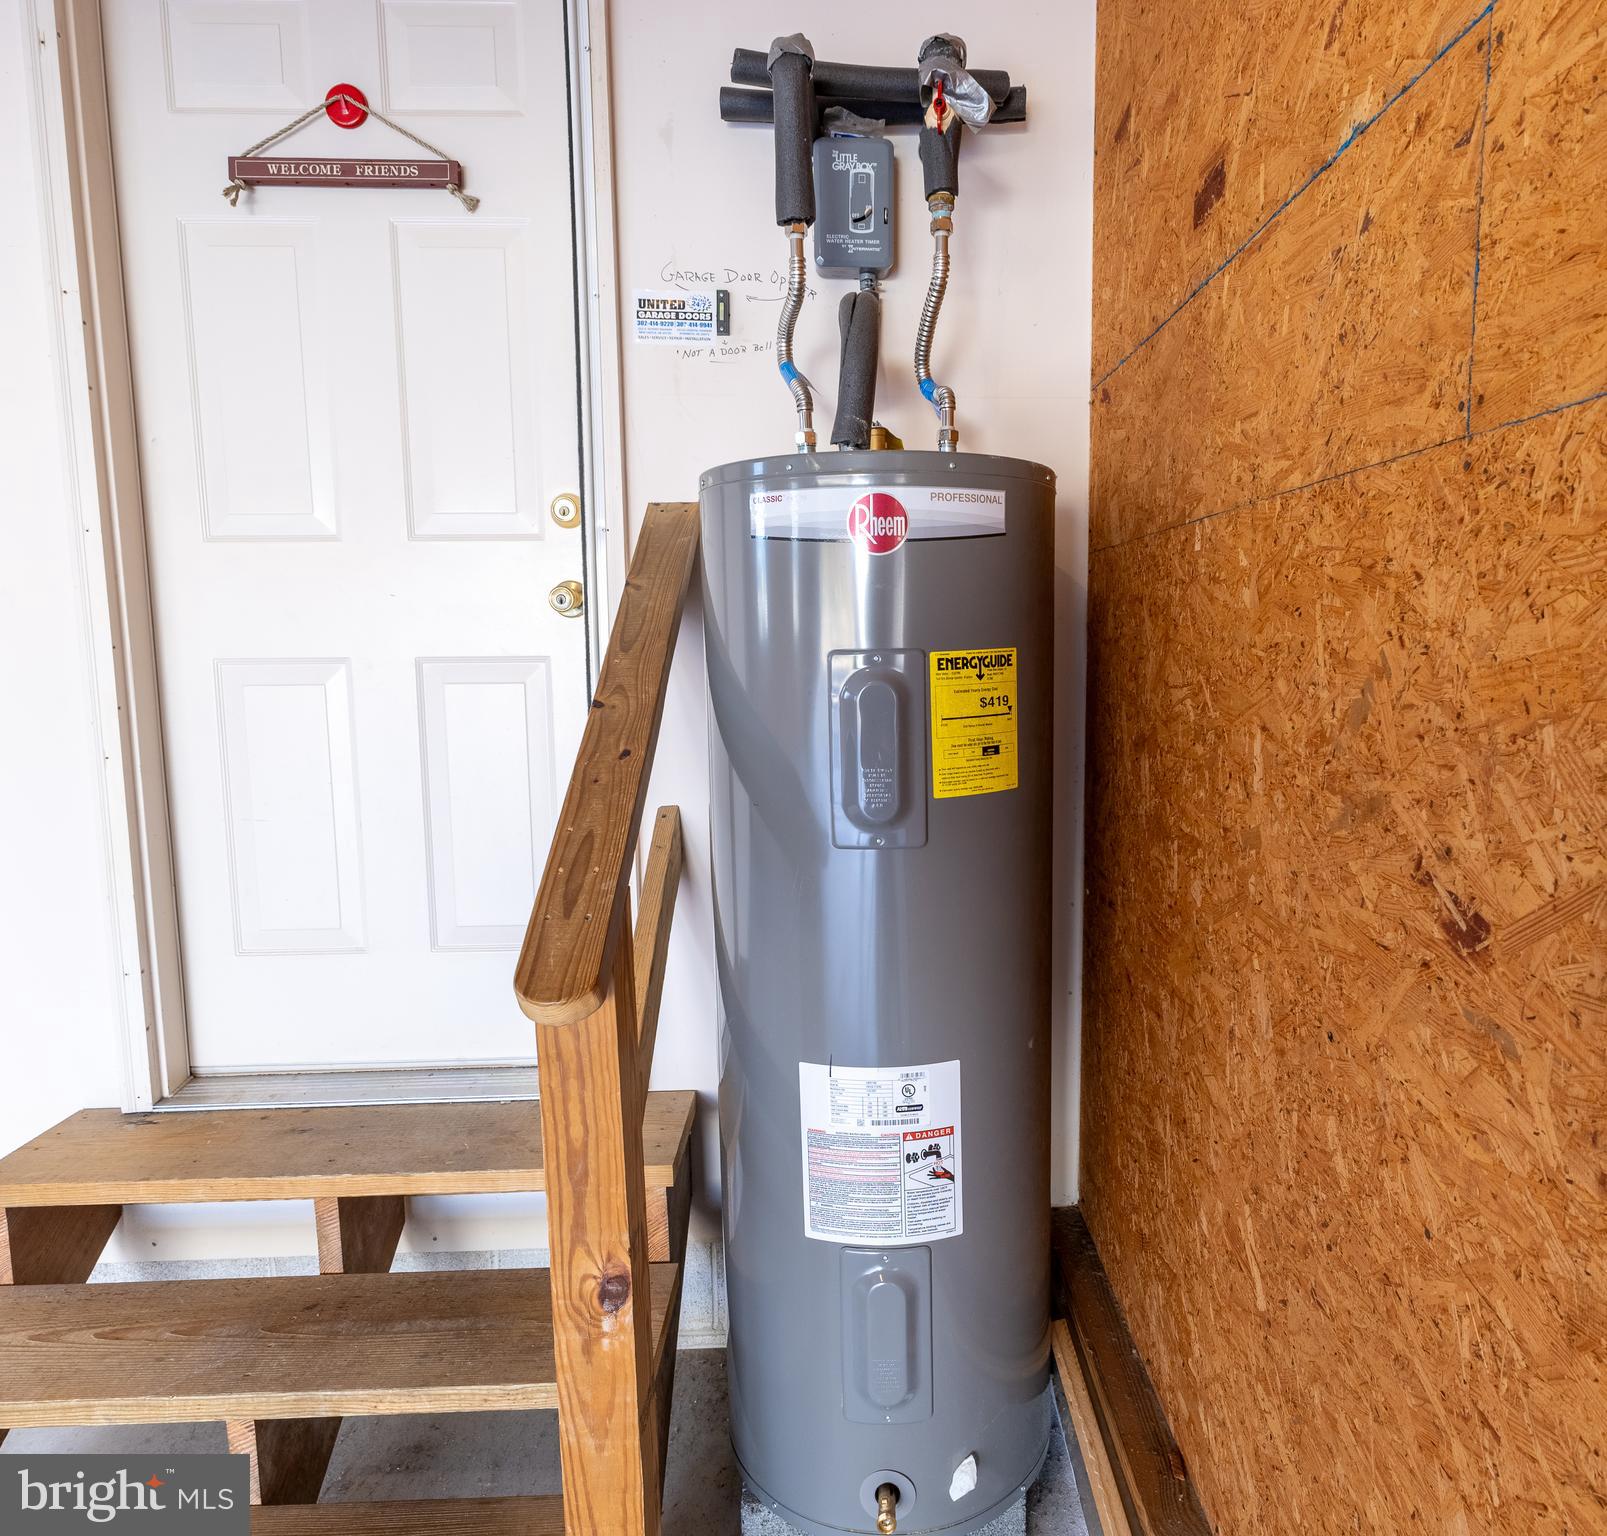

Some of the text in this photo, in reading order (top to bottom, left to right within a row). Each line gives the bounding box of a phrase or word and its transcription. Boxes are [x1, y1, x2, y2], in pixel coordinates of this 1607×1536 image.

[267, 164, 419, 177] WELCOME FRIENDS
[832, 161, 855, 171] GRAY
[660, 261, 716, 283] GARAGE
[724, 268, 763, 284] DOOR
[638, 298, 706, 310] UNITED 24/7
[638, 311, 711, 321] GARAGE DOORS
[682, 349, 705, 359] NOT
[709, 349, 716, 357] A
[721, 346, 747, 356] DOOR
[752, 492, 1003, 505] CLASSIC PROFESSIONAL
[850, 493, 906, 545] Rheem
[937, 654, 1013, 671] ENERGYGUIDE
[979, 695, 1009, 709] $419
[915, 1127, 951, 1140] DANGER
